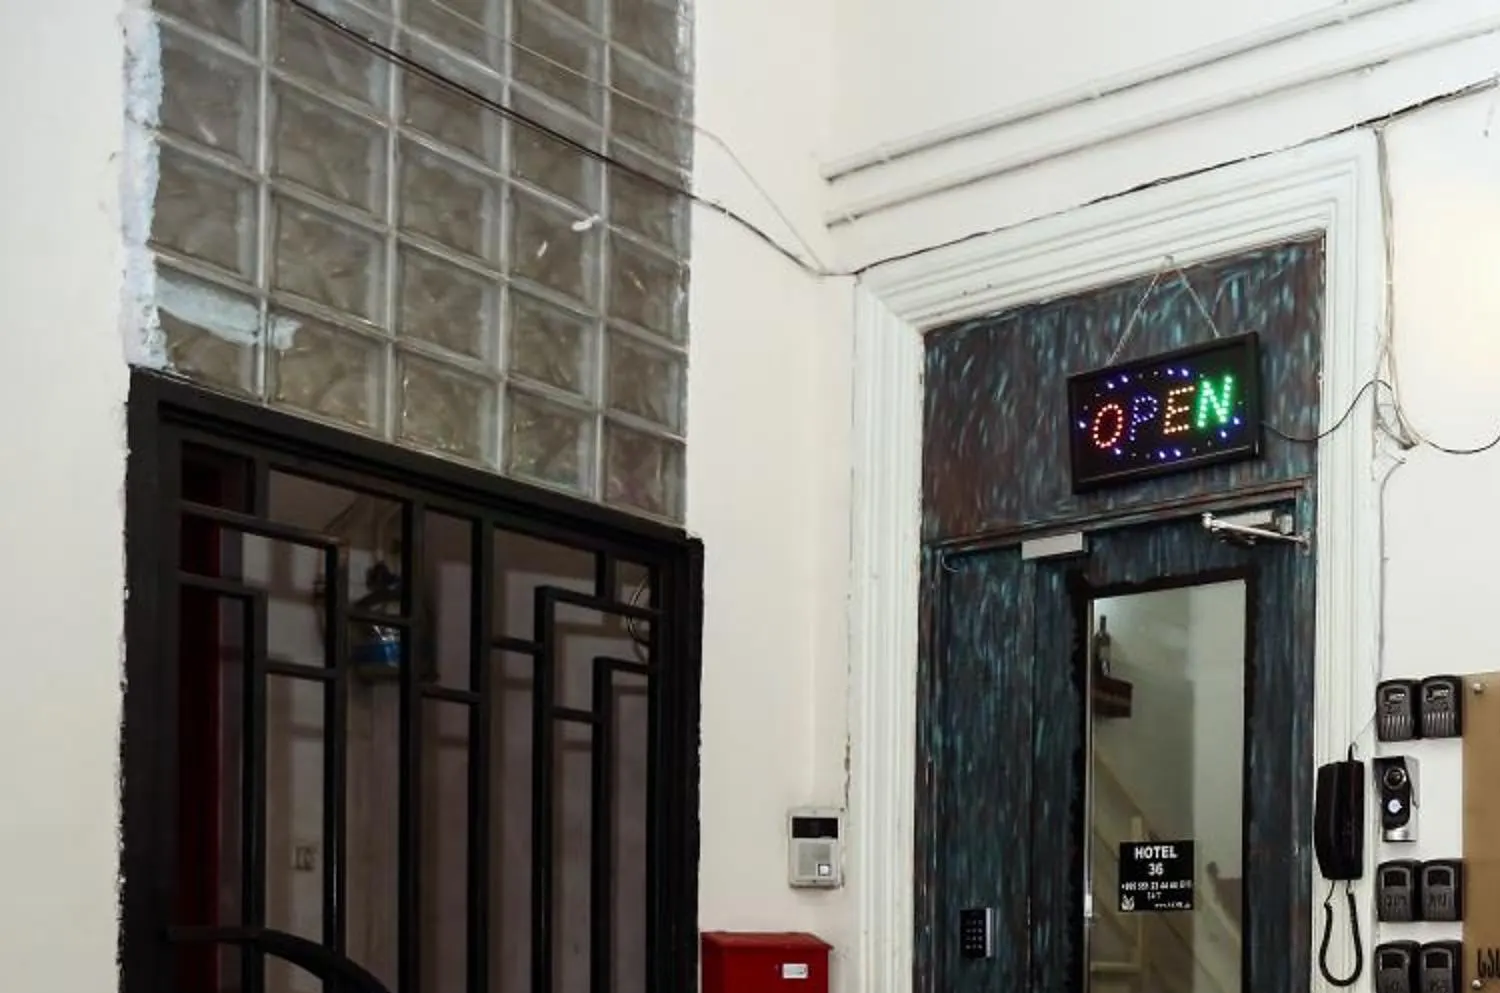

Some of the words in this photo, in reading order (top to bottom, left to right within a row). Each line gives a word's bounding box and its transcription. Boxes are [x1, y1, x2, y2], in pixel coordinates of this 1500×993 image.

[1092, 374, 1234, 448] OPEN
[1134, 845, 1178, 860] HOTEL
[1147, 862, 1164, 876] 36
